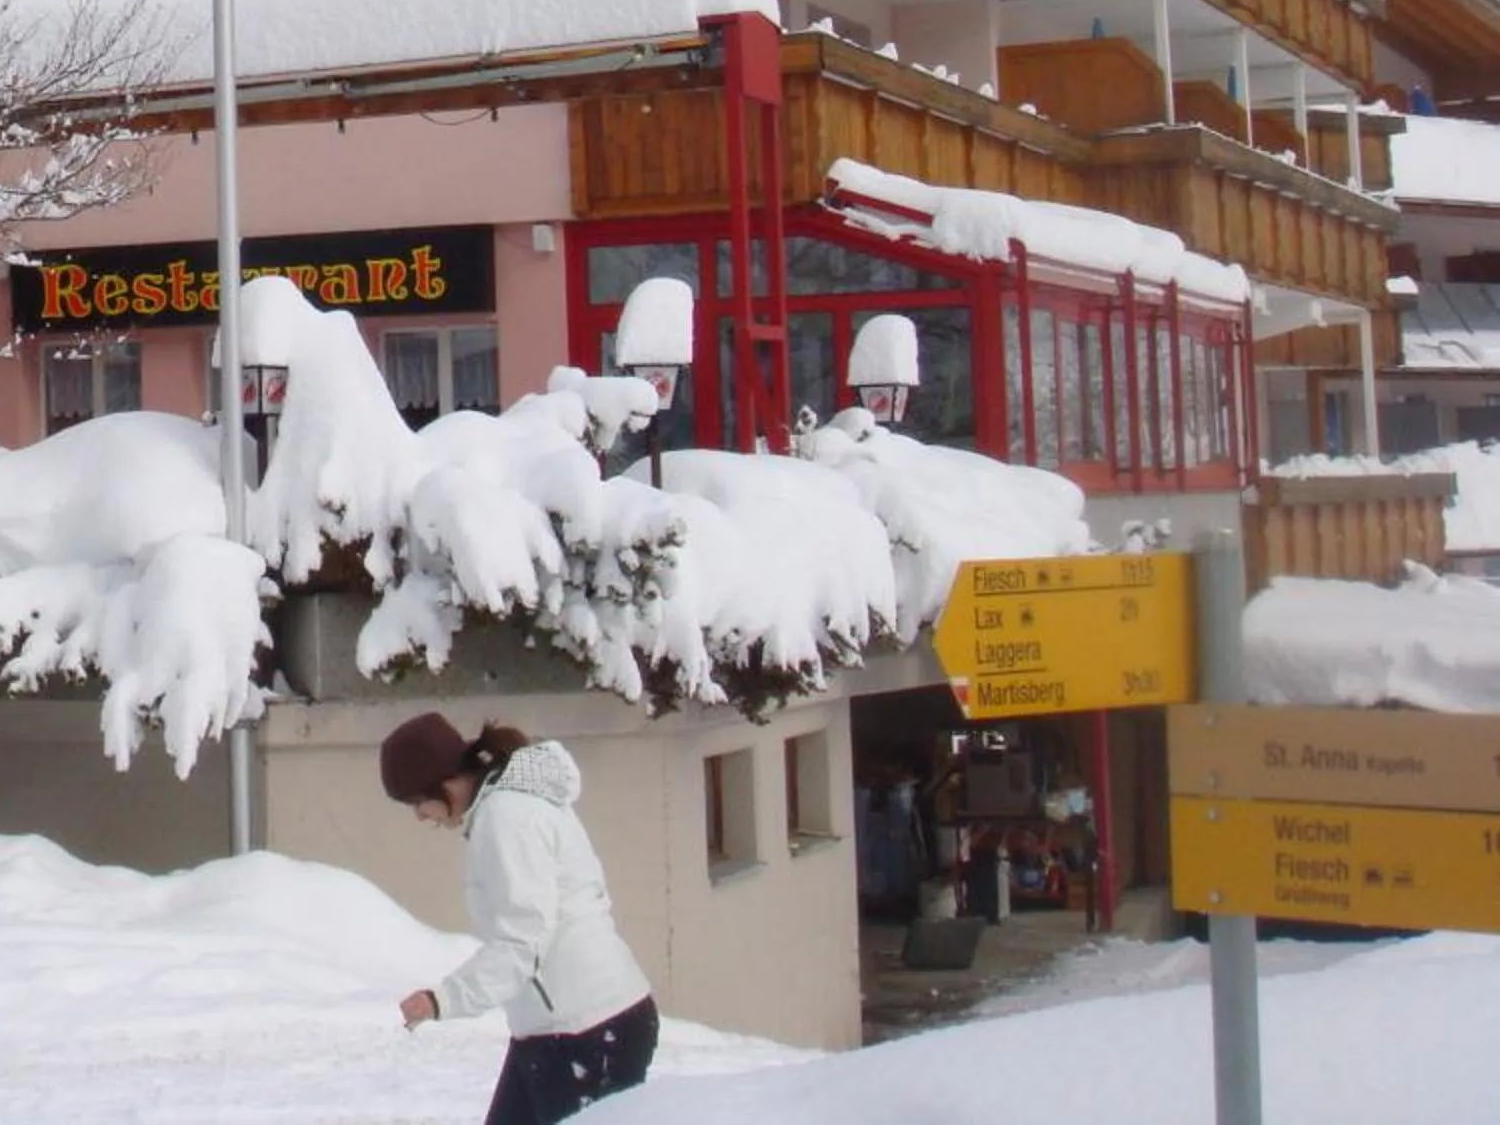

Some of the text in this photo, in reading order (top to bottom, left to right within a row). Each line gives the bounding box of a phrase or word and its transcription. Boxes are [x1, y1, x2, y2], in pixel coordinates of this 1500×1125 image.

[40, 244, 447, 320] Restarant
[972, 565, 1027, 591] Fiesch
[974, 606, 1003, 631] Lax
[975, 638, 1043, 669] Laggera
[976, 676, 1066, 708] Martisberg
[1301, 743, 1359, 773] Anna
[1272, 814, 1351, 845] Wichel
[1274, 851, 1350, 883] Fiesch
